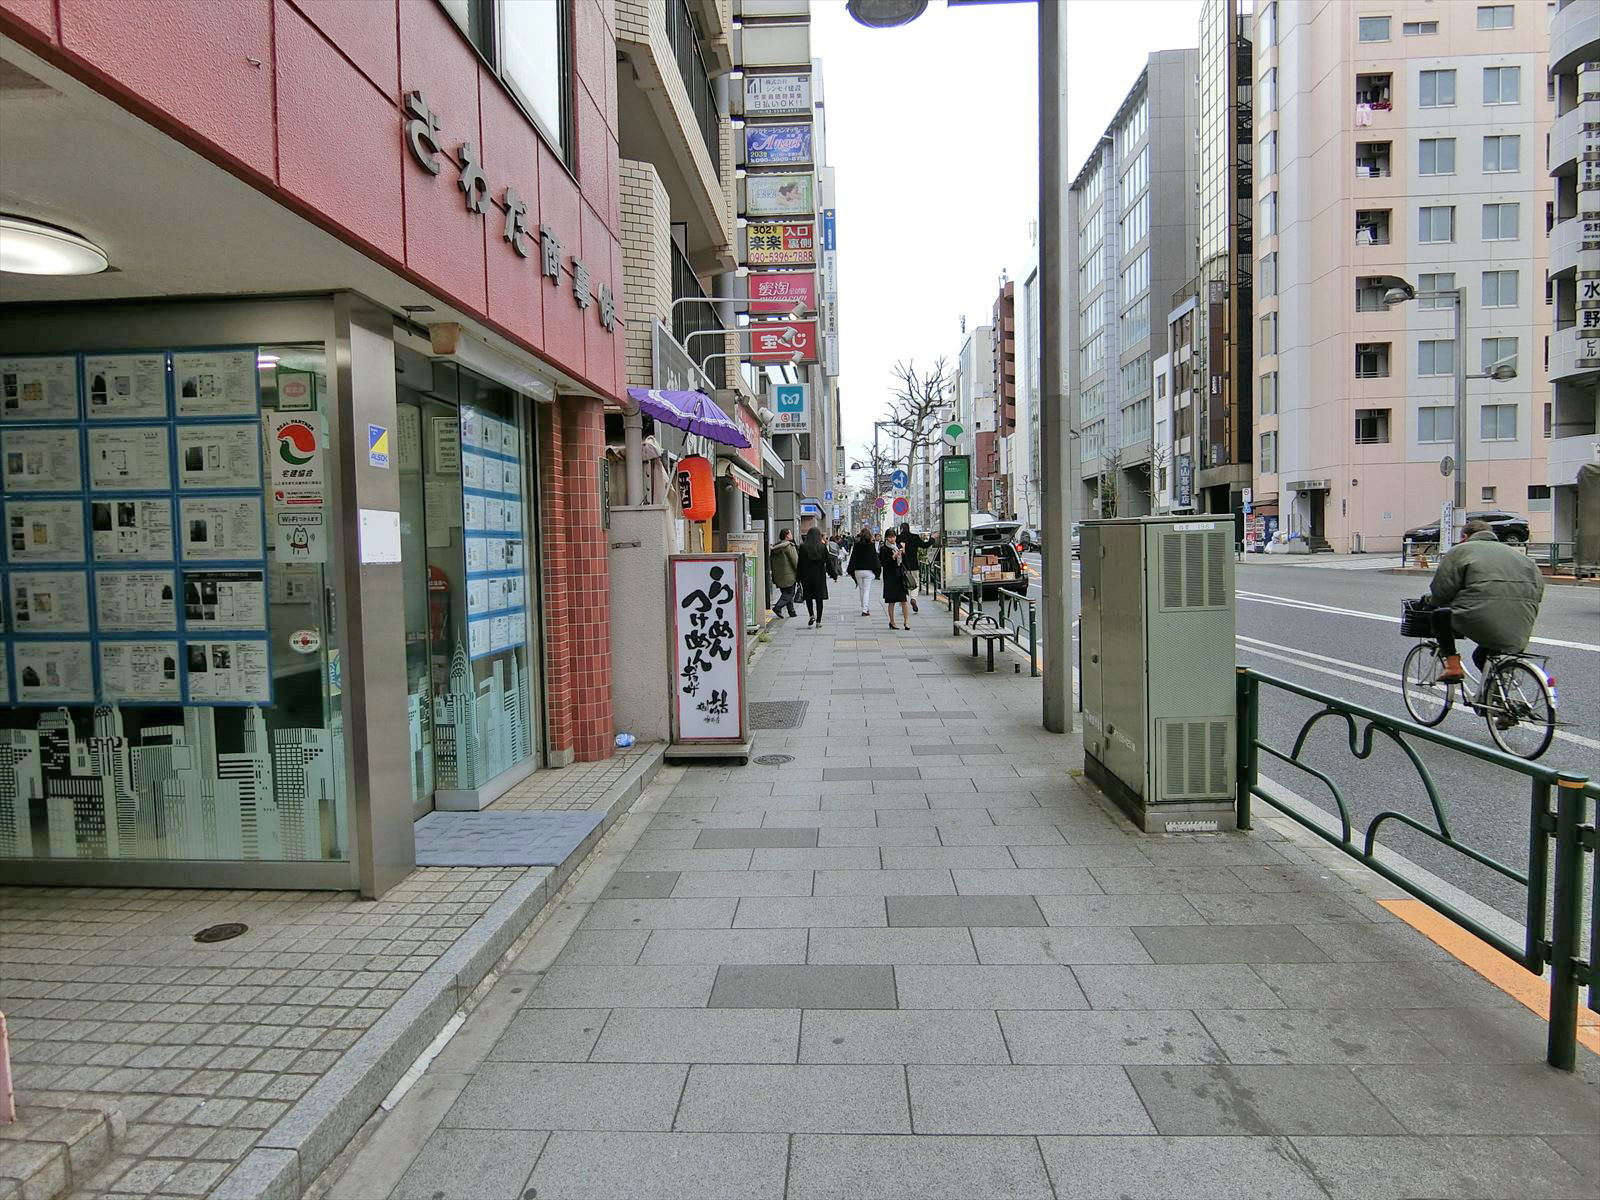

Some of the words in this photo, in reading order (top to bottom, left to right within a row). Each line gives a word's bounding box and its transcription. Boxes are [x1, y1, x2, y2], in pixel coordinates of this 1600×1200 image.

[785, 226, 808, 236] 入口
[750, 236, 781, 250] 楽楽
[787, 238, 811, 249] 裏側
[750, 251, 813, 263] 090-5396-7888
[761, 333, 807, 350] 宝くじ
[276, 421, 289, 432] REAL
[291, 419, 314, 431] PARTNER
[371, 453, 388, 462] ALSOK
[282, 469, 314, 478] 宅建協会
[708, 565, 734, 661] らーめん
[682, 589, 713, 672] つけめん
